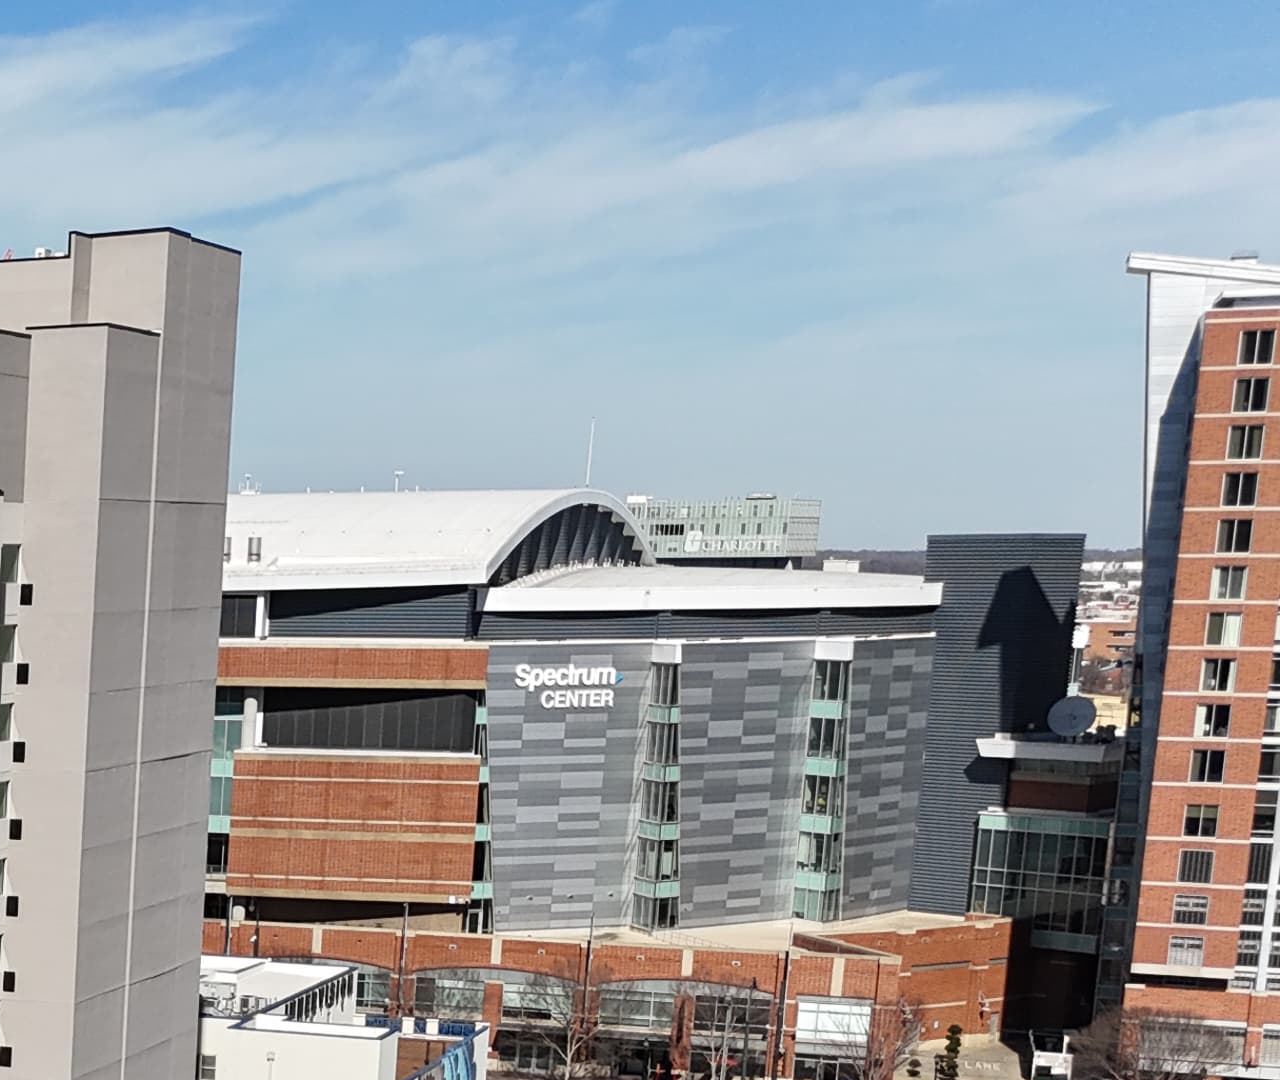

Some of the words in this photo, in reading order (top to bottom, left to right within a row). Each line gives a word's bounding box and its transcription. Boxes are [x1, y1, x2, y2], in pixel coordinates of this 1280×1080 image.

[702, 539, 782, 552] CHARLOTTE
[514, 662, 617, 692] Spectrum
[540, 689, 615, 709] CENTER
